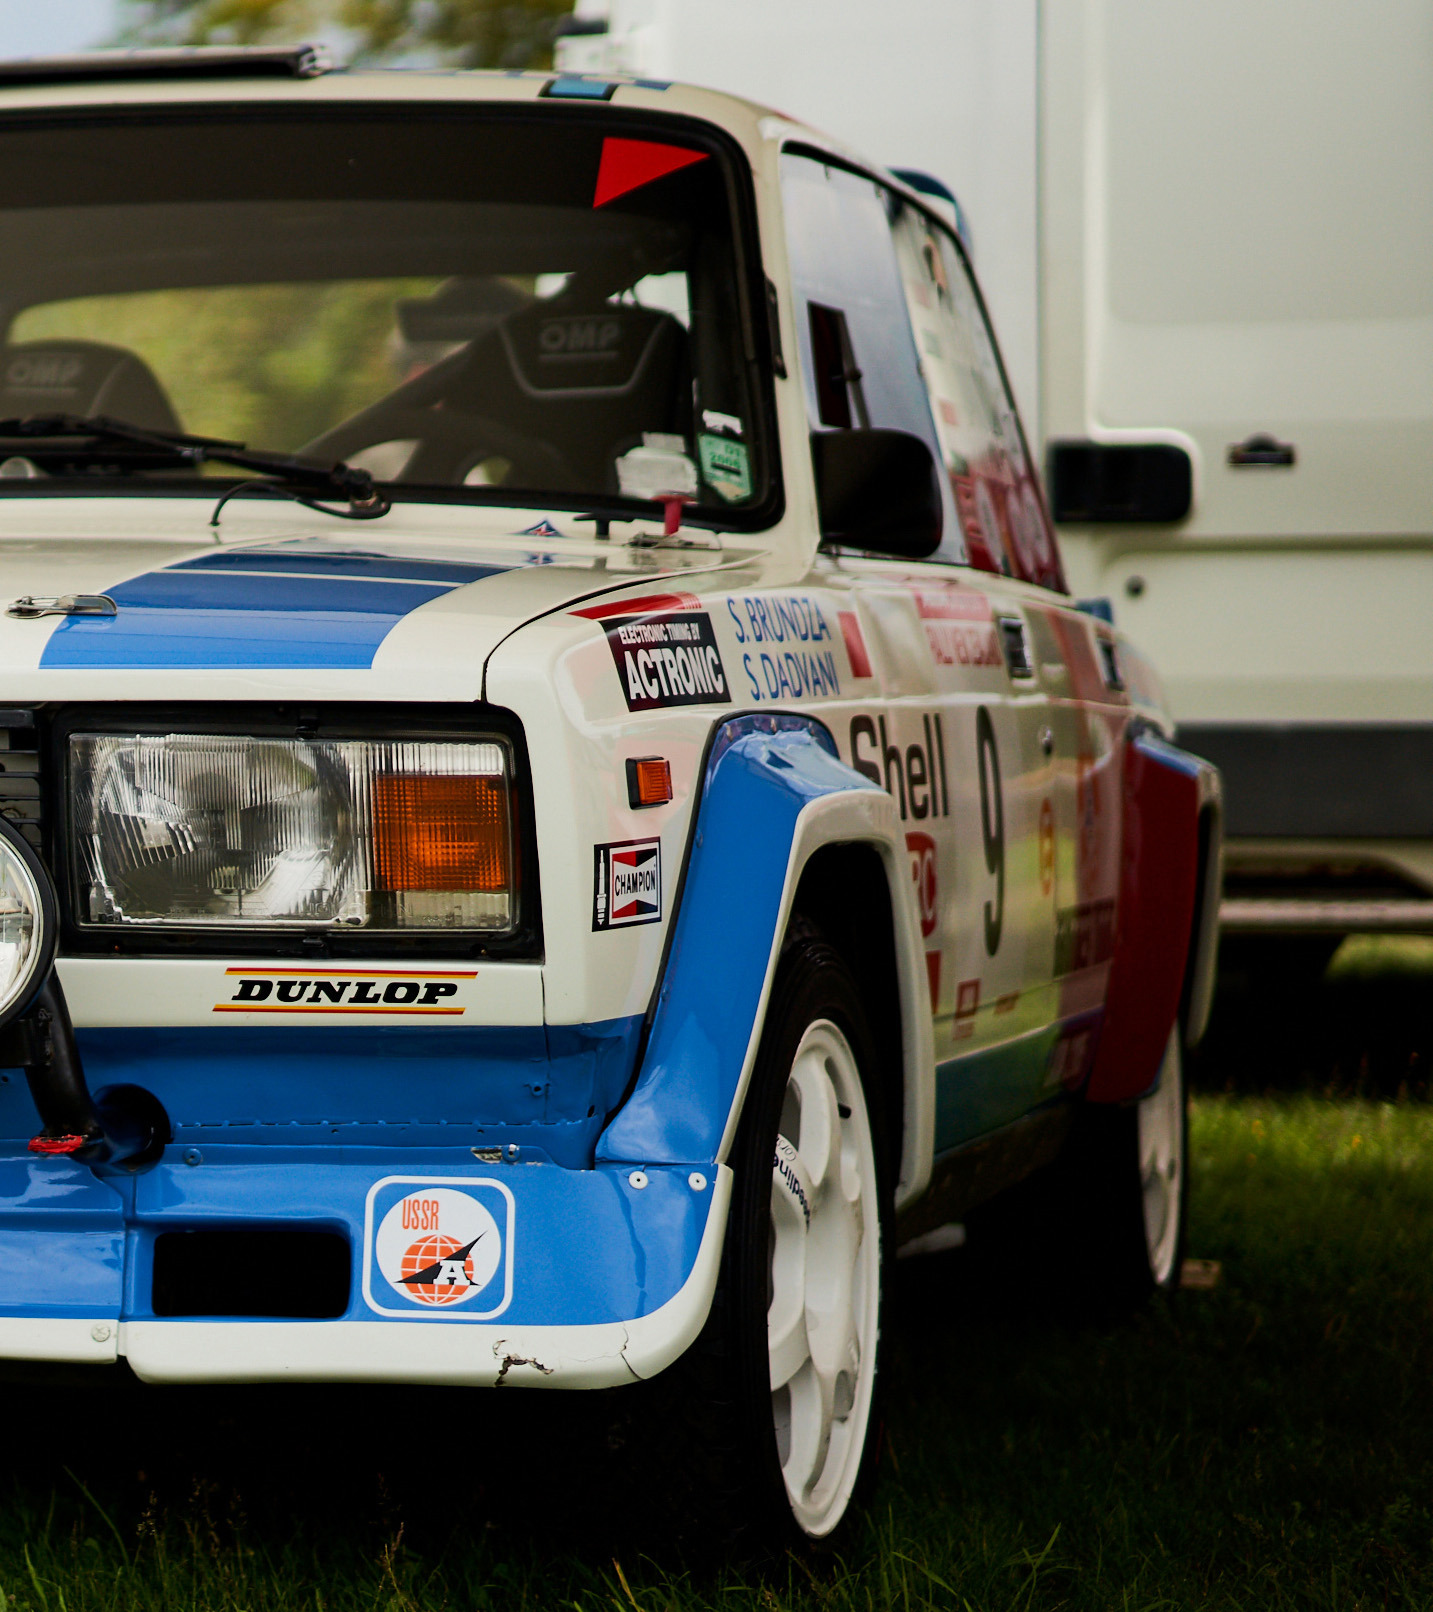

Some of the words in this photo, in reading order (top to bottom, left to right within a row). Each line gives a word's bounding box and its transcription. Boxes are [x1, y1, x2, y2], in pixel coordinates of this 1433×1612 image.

[618, 624, 668, 645] ELECTRONIC
[665, 623, 692, 641] TIMING
[690, 622, 701, 640] BY
[727, 597, 750, 643] S.
[750, 597, 832, 643] BRUNDZA
[624, 645, 724, 700] ACTRONIC
[743, 652, 766, 701] S.
[762, 650, 840, 699] DADVANI
[850, 712, 950, 822] Shell
[976, 705, 1005, 957] 9
[615, 868, 656, 897] CHAMPION
[231, 980, 458, 1004] DUNLOP
[402, 1199, 440, 1231] USSR
